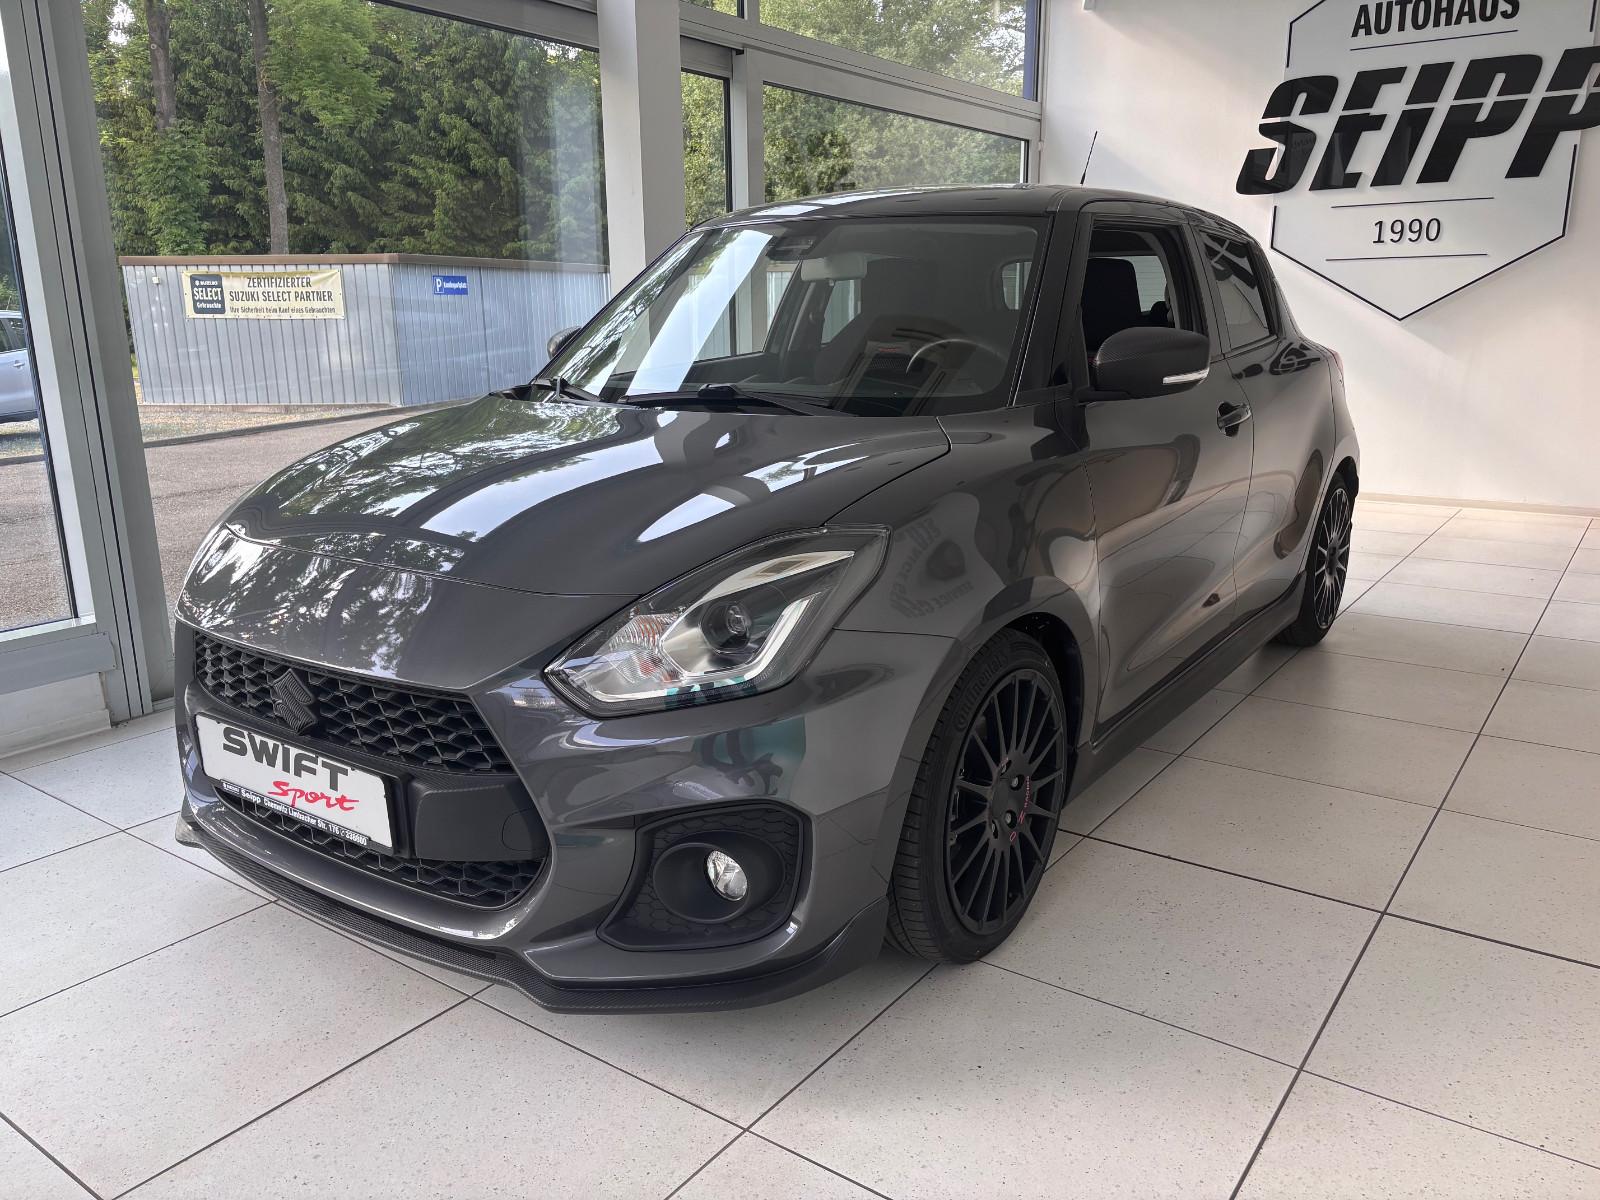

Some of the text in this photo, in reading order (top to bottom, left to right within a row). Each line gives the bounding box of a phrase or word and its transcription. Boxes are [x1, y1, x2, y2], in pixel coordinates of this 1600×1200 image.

[1351, 0, 1520, 38] AUTOHAUS
[1235, 45, 1600, 196] SEIPP
[1371, 217, 1442, 245] 1990
[193, 287, 222, 301] SELECT
[229, 290, 333, 302] SUZUKI SELECT PARTNER
[247, 276, 312, 288] ZERTIFIZIERTER
[240, 306, 265, 314] Sicherheit
[222, 726, 349, 792] SWIFT
[241, 789, 261, 804] Seipp
[317, 819, 328, 830] Str.
[267, 780, 360, 812] Sport
